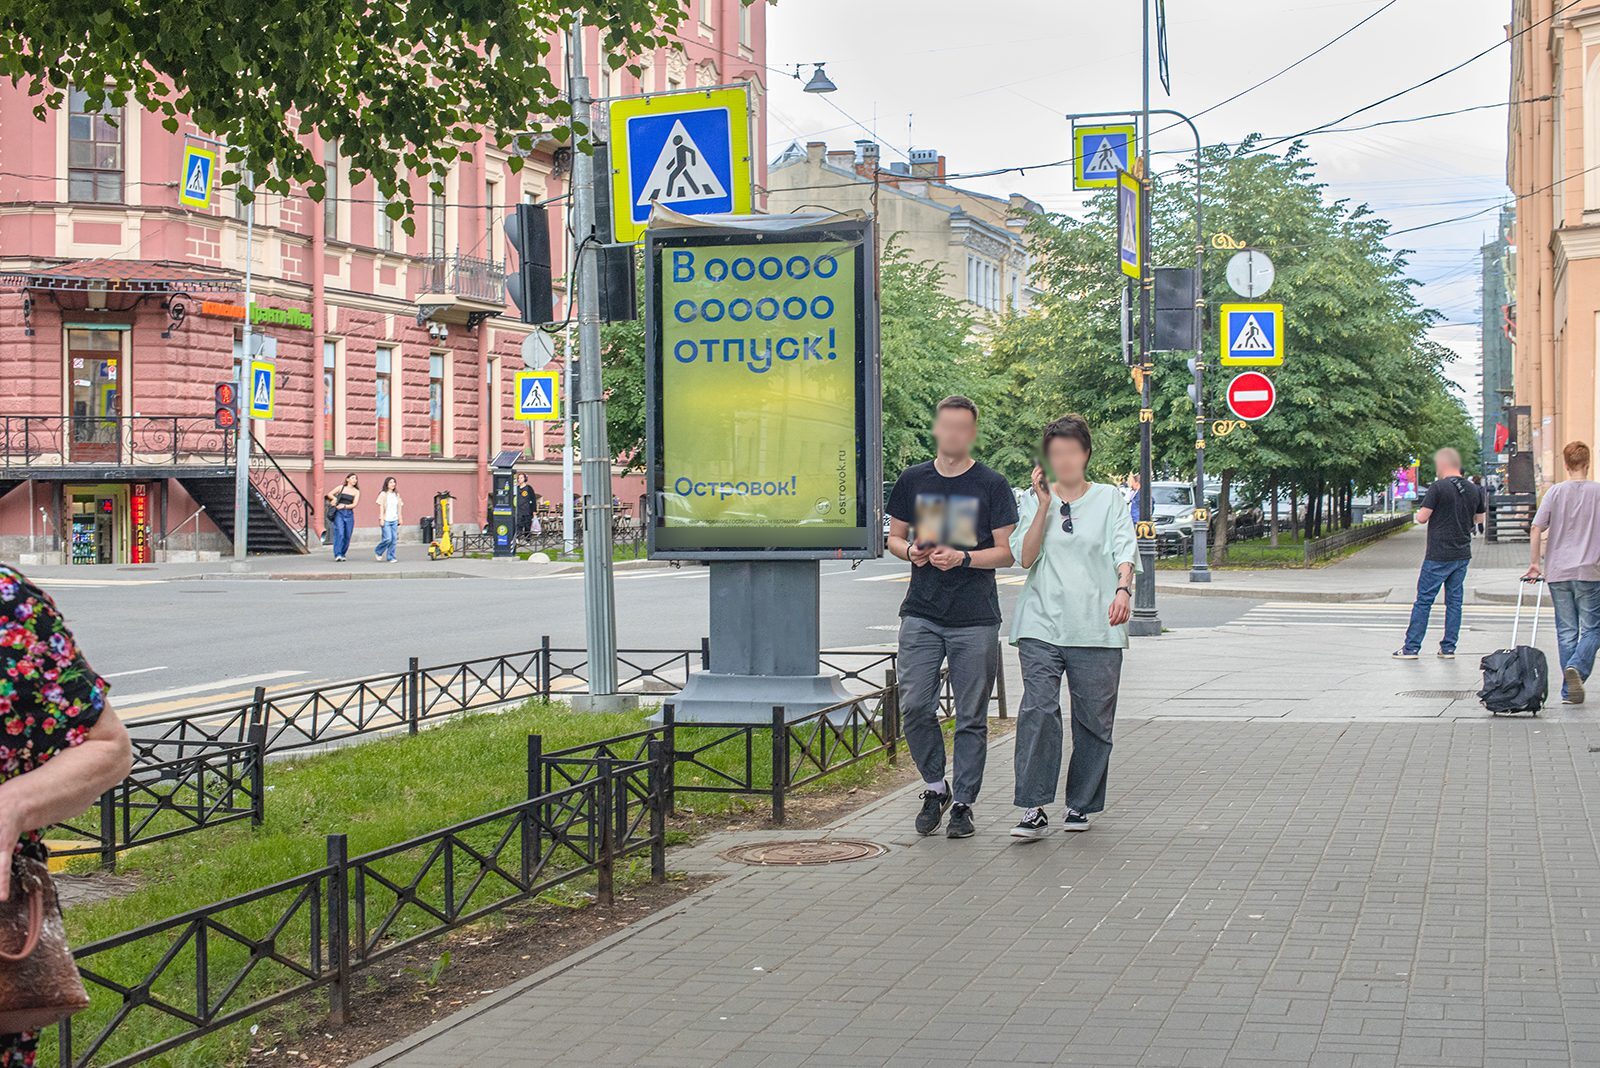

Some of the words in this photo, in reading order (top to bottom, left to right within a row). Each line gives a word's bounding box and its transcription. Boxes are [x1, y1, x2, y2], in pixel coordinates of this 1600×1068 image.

[673, 251, 695, 283] В
[704, 254, 839, 282] ооооо
[674, 296, 835, 323] сооооо
[674, 328, 837, 373] отпуск!
[674, 475, 797, 501] Островок!
[836, 449, 847, 515] ostrovok.ru
